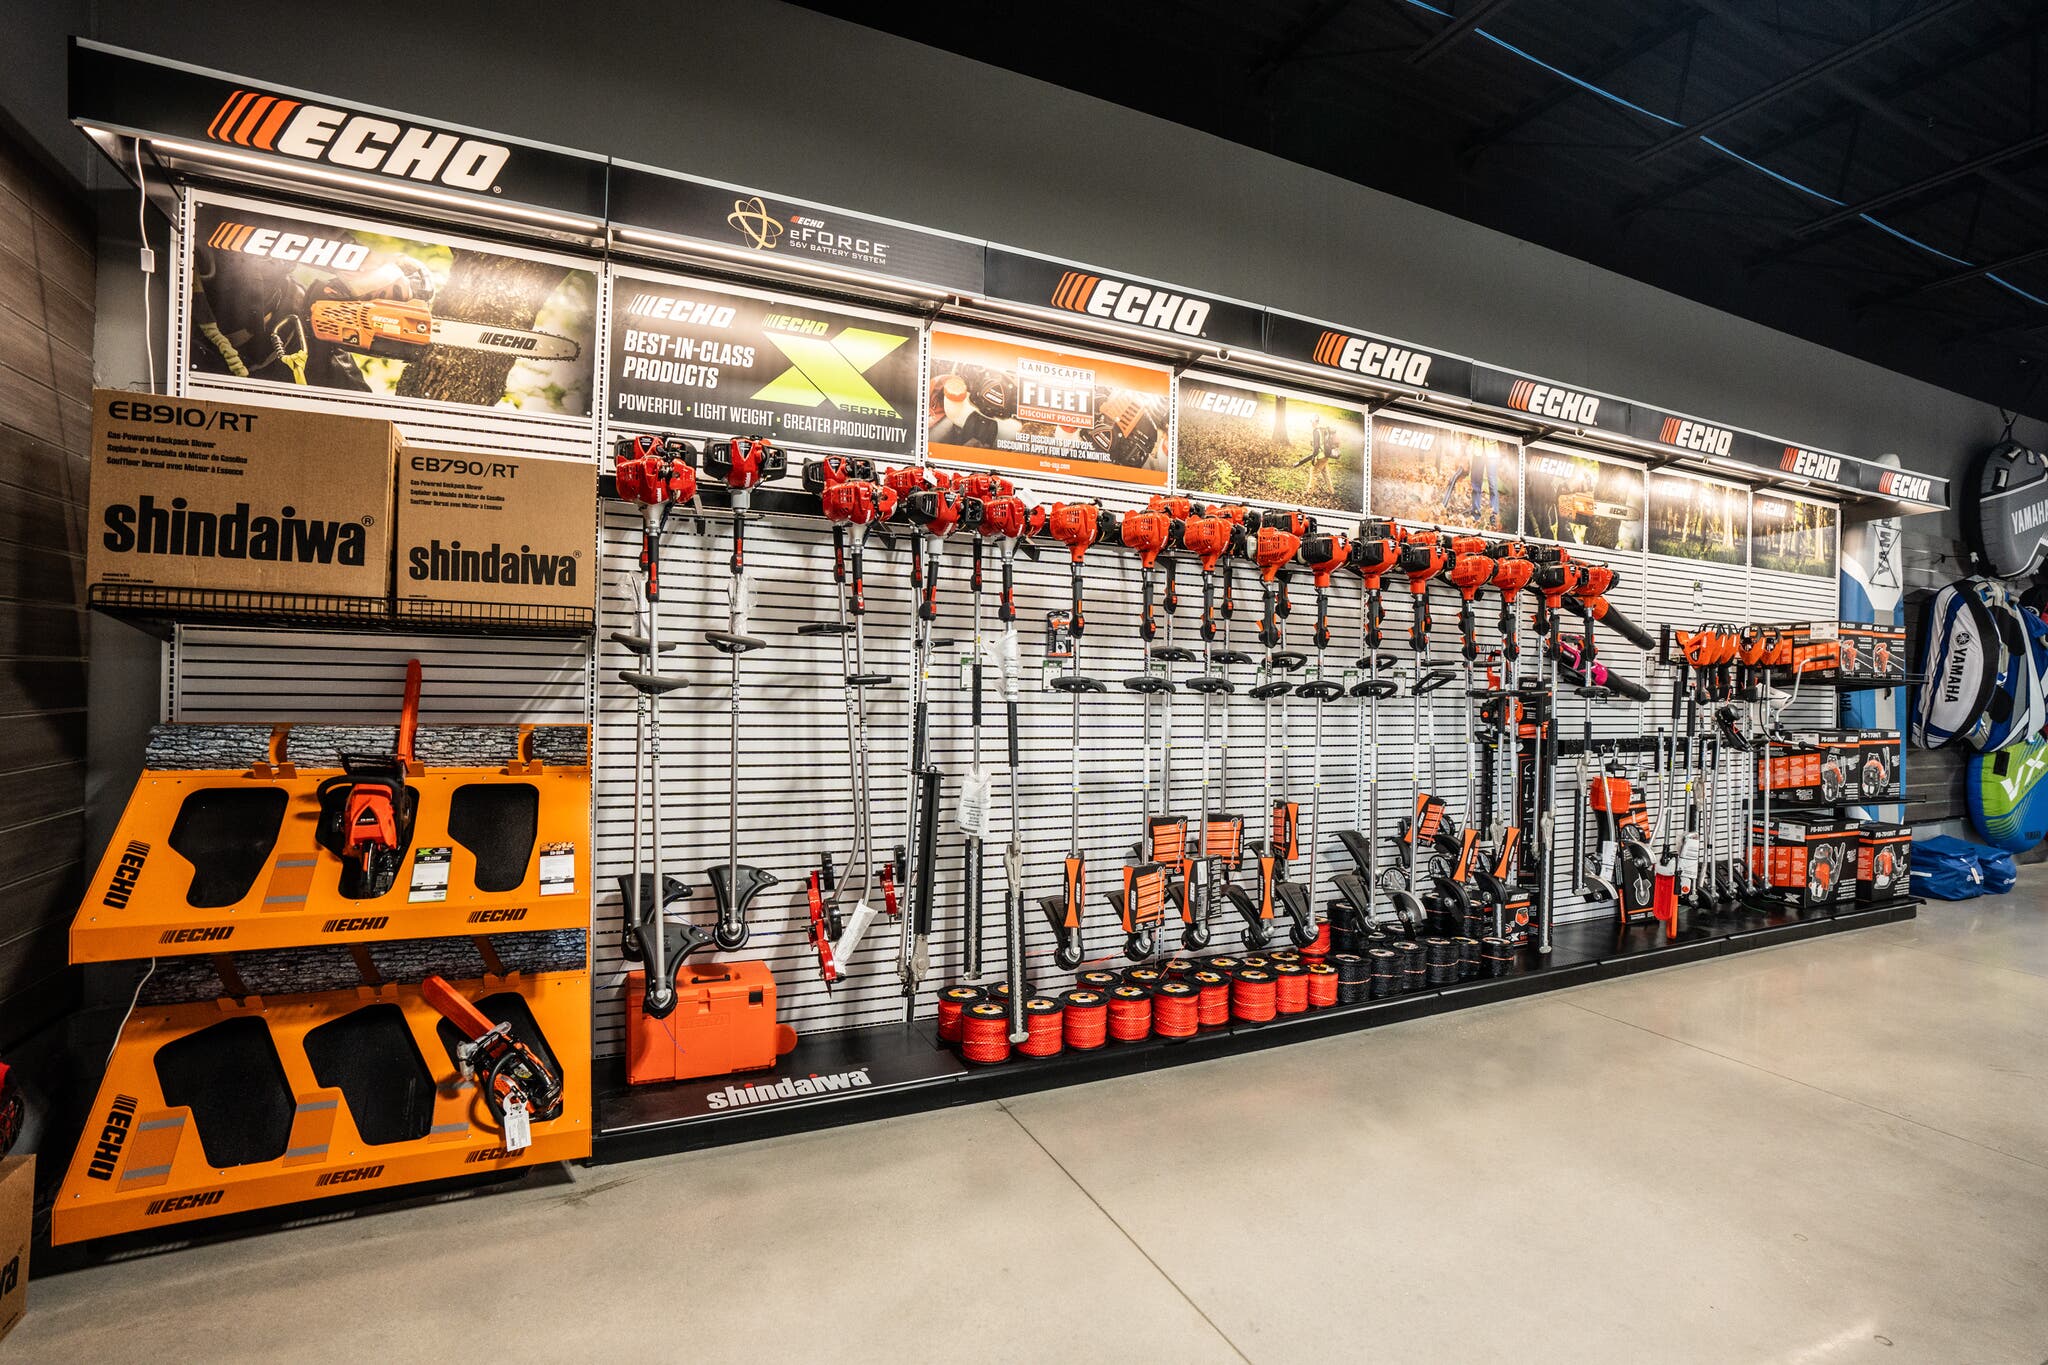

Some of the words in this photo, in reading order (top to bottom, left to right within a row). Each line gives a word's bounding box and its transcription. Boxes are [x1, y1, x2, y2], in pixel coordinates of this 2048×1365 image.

[277, 105, 511, 191] ECHO
[797, 217, 825, 229] ECHO
[244, 228, 370, 271] ECHO
[790, 228, 887, 258] eFORCE
[790, 240, 808, 249] 56V
[810, 244, 850, 257] BATTERY
[852, 252, 886, 265] SYSTEM
[650, 298, 737, 328] ECHO
[1087, 279, 1211, 336] ECHO
[778, 315, 830, 336] ECHO
[490, 333, 538, 350] ECHO
[624, 329, 755, 368] BEST-IN-CLASS
[622, 356, 719, 389] PRODUCTS
[1020, 361, 1092, 381] LANDSCAPER
[1338, 337, 1432, 386] ECHO
[839, 403, 898, 417] SERIES
[1022, 380, 1090, 413] FLEET
[1201, 391, 1258, 419] ECHO
[1527, 385, 1600, 425] ECHO
[109, 401, 259, 433] EB910/RT
[618, 393, 683, 417] POWERFUL
[694, 402, 727, 421] LIGHT
[730, 405, 774, 427] WEIGHT
[783, 413, 832, 432] GREATER
[833, 417, 908, 443] PRODUCTIVITY
[1020, 409, 1056, 421] DISCOUNT
[1057, 414, 1092, 426] PROGRAM
[107, 431, 155, 443] Gas-Powered
[156, 436, 190, 446] Backpack
[191, 440, 217, 449] Blower
[997, 439, 1030, 451] DISCOUNTS
[1030, 443, 1048, 454] APPLY
[1049, 446, 1060, 455] FOR
[1061, 448, 1069, 457] UP
[1070, 449, 1078, 458] TO
[1078, 450, 1086, 459] 24
[1087, 451, 1112, 462] MONTHS.
[1015, 433, 1029, 441] DEEP
[1031, 434, 1062, 446] DISCOUNTS
[1063, 440, 1071, 448] UP
[1071, 440, 1080, 448] TO
[1389, 427, 1436, 450] ECHO
[1675, 420, 1734, 455] ECHO
[411, 456, 519, 478] EB790/RT
[1539, 458, 1576, 479] ECHO
[1793, 451, 1842, 480] ECHO
[1890, 474, 1932, 500] ECHO
[1763, 502, 1787, 517] ECHO
[103, 495, 367, 566] shindaiwa
[409, 540, 576, 587] shindaiwa
[1944, 648, 1967, 703] YAMAHA
[103, 852, 148, 910] ECHO
[334, 916, 389, 933] ECHO
[477, 908, 528, 925] ECHO
[173, 926, 235, 943] ECHO
[707, 1069, 871, 1110] shindaiwa
[87, 1109, 136, 1181] ECHO
[328, 1165, 385, 1185] ECHO
[160, 1190, 224, 1216] ECHO
